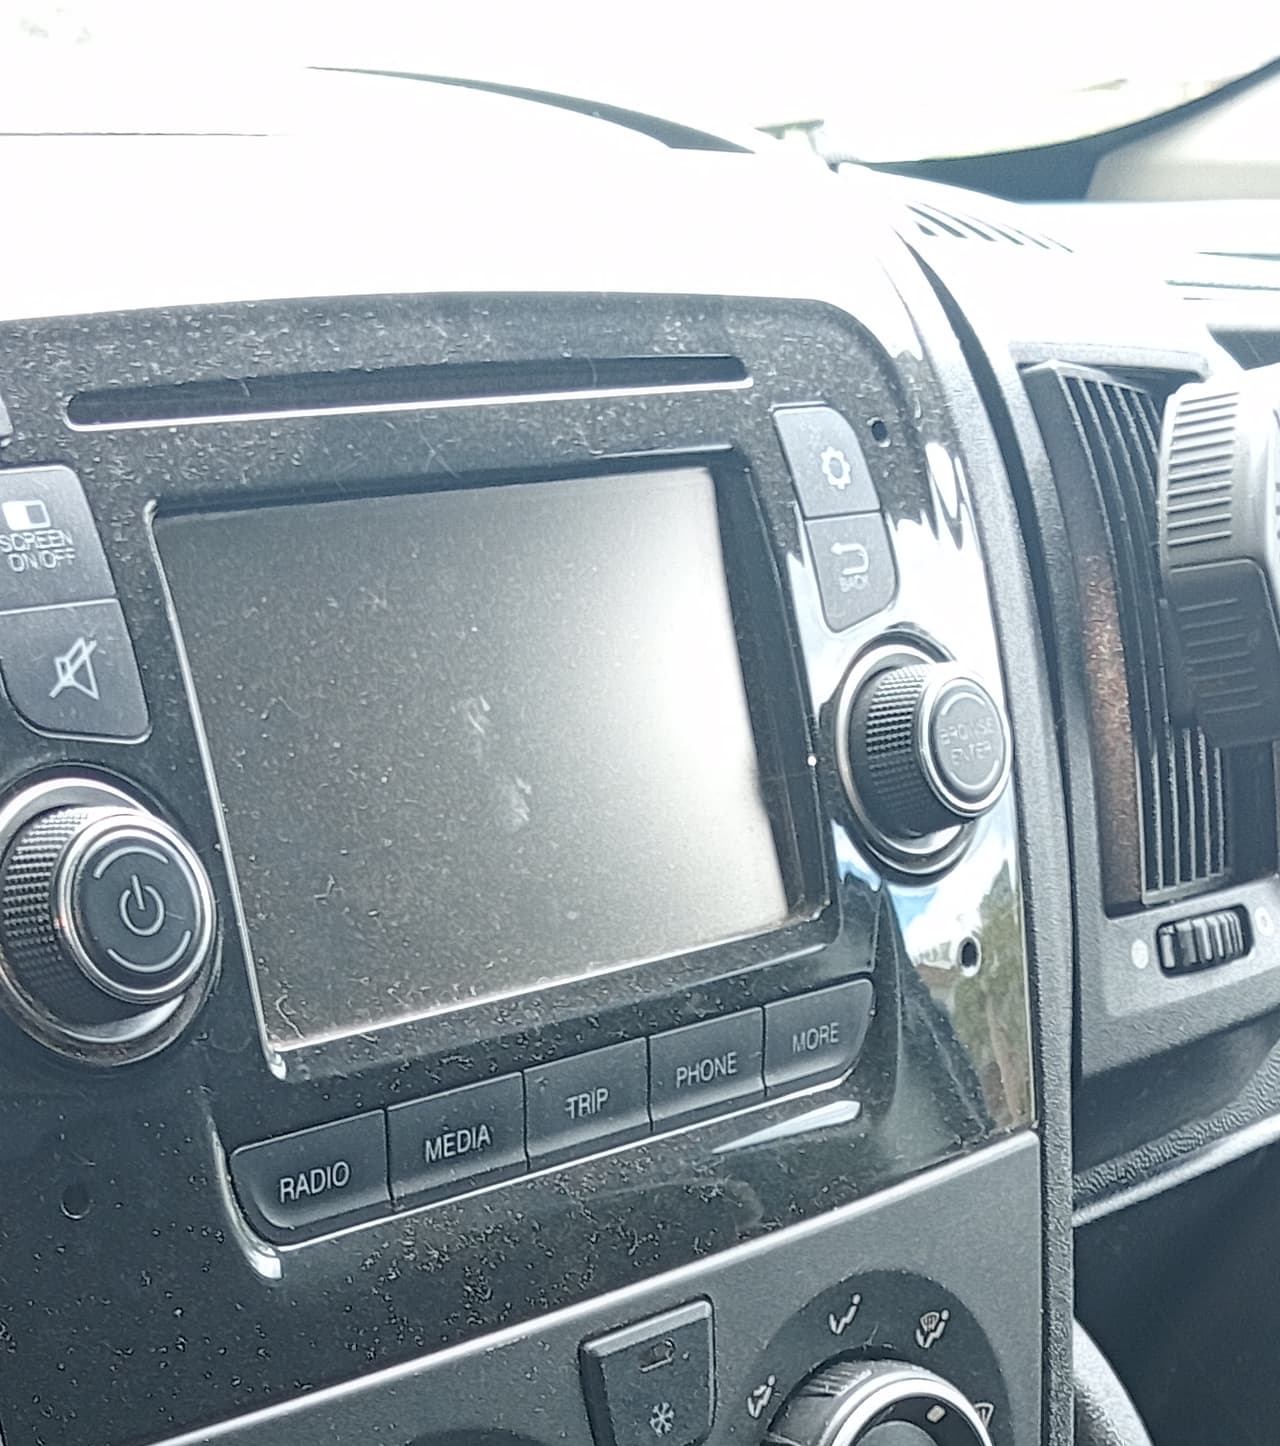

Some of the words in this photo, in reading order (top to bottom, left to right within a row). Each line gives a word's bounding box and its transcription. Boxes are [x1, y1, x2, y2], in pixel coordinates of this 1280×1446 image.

[792, 1021, 839, 1052] MORE
[675, 1051, 738, 1089] PHONE
[565, 1087, 609, 1119] TRIP
[425, 1124, 491, 1163] MEDIA
[279, 1160, 351, 1203] RADIO
